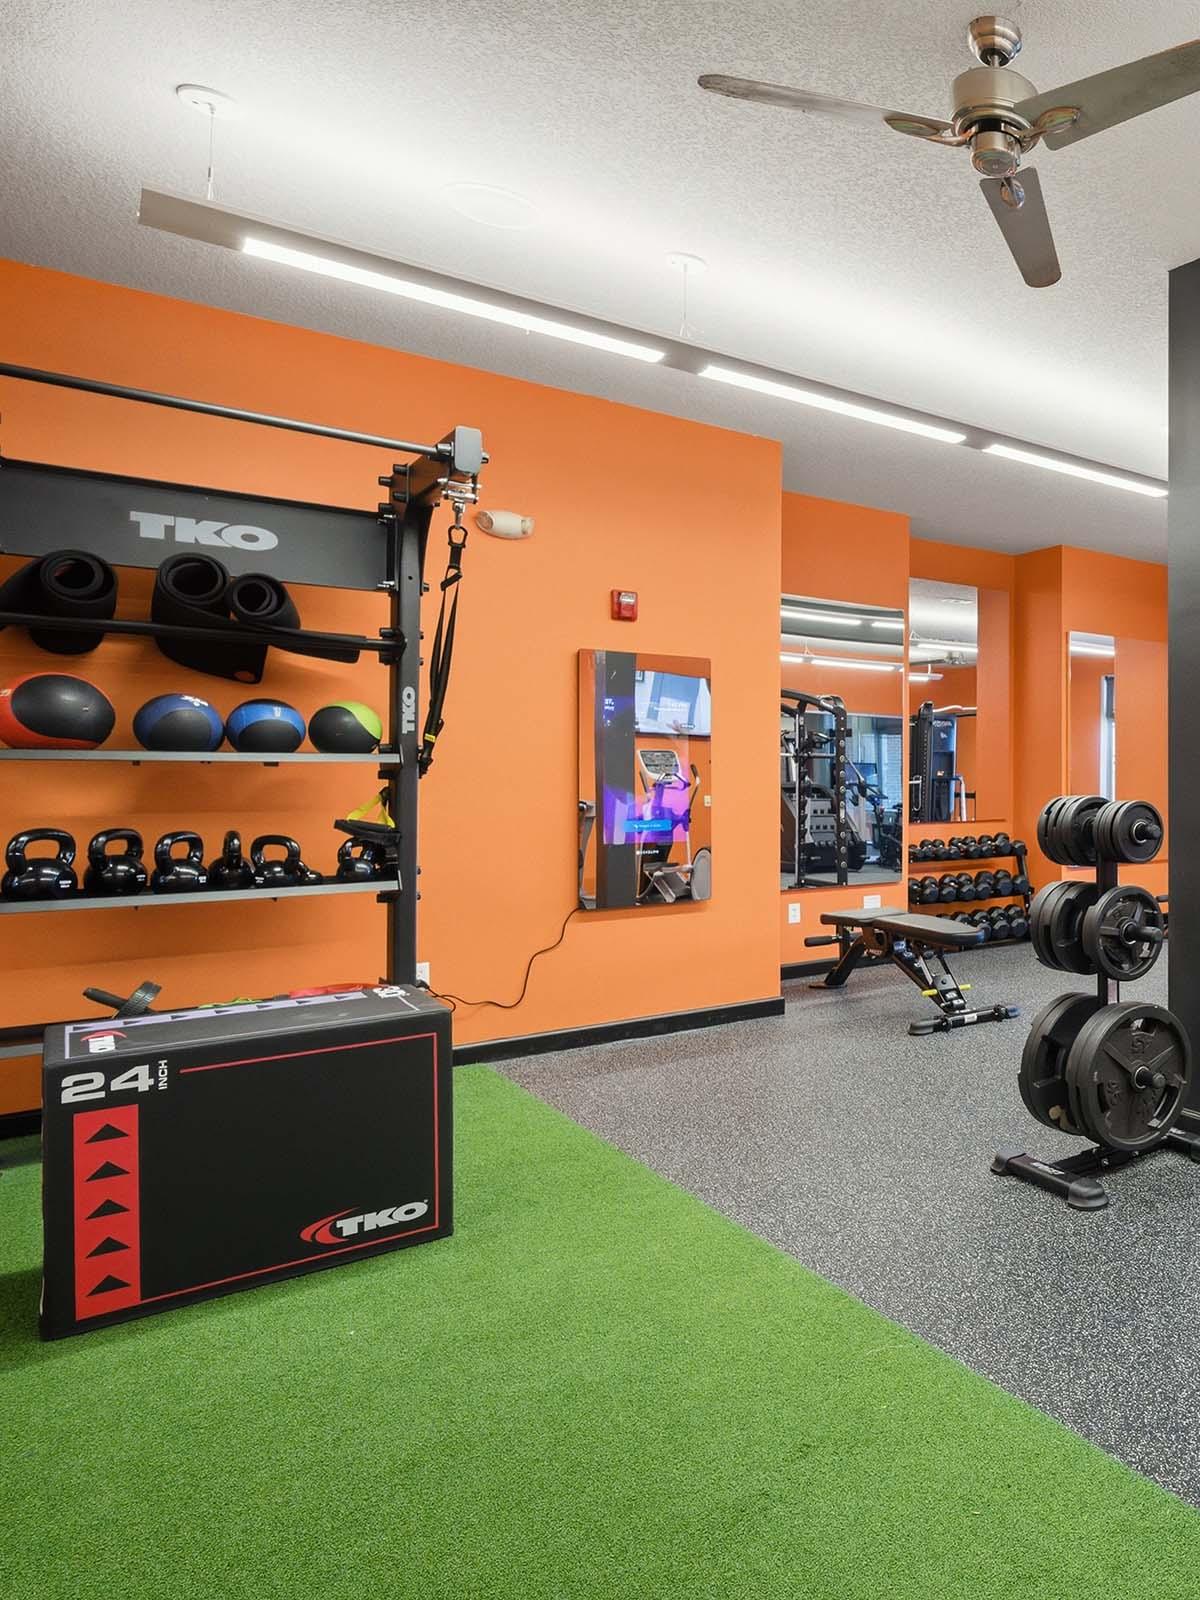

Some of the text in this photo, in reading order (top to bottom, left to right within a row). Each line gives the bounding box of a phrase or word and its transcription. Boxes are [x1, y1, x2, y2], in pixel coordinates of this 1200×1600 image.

[129, 510, 279, 552] TKO
[402, 686, 416, 734] TKO
[61, 1059, 168, 1104] 24 INCH
[336, 1201, 429, 1237] TKO
